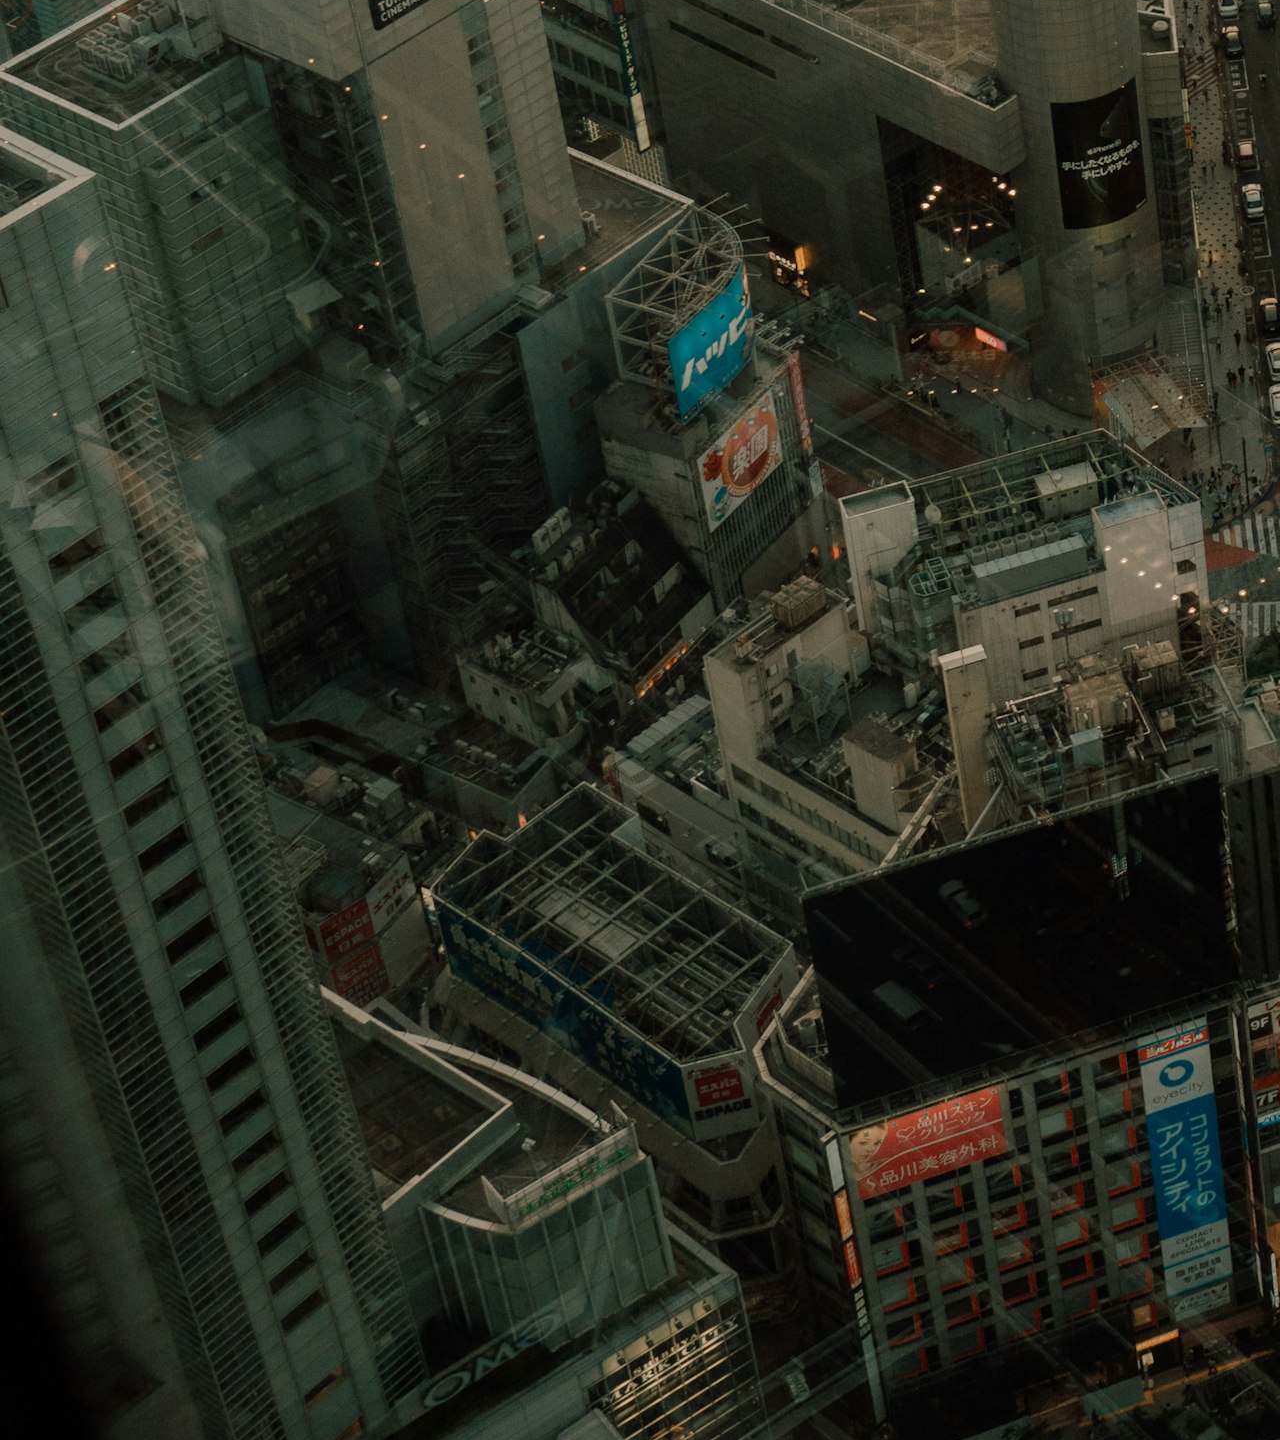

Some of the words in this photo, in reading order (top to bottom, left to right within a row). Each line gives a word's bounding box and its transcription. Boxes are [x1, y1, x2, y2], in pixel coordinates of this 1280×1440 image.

[728, 425, 769, 482] 楽園
[325, 915, 369, 946] ESPACE
[1249, 1014, 1270, 1034] 9F
[700, 1077, 739, 1095] エスパス
[1151, 1079, 1204, 1105] eyecity
[1256, 1089, 1278, 1106] 7F
[696, 1098, 751, 1122] ESPACE
[917, 1095, 996, 1128] 品川スキン
[919, 1110, 988, 1145] クリニック
[880, 1133, 1000, 1186] 品川美容外科
[1156, 1121, 1192, 1215] アイシティ
[1187, 1112, 1218, 1209] コンタクトの
[1170, 1236, 1222, 1260] SPECIALISTS
[1176, 1227, 1213, 1245] CONTACT
[1185, 1236, 1206, 1249] LENS
[602, 1366, 668, 1408] MARK
[680, 1317, 739, 1359] CITY
